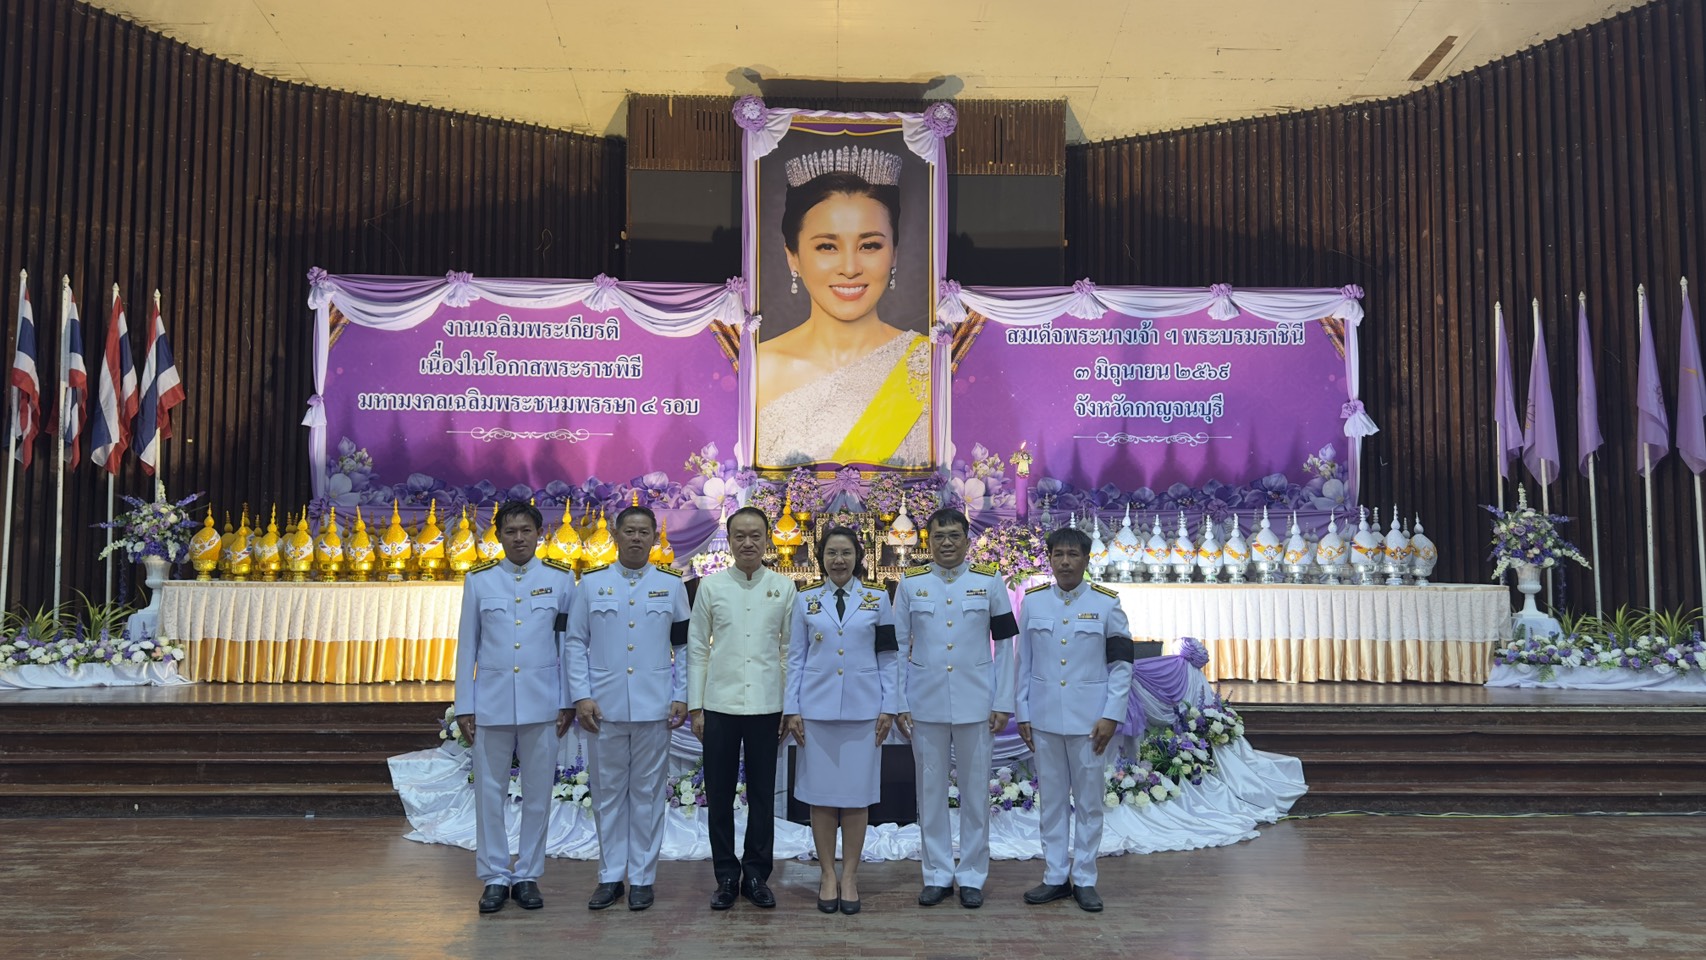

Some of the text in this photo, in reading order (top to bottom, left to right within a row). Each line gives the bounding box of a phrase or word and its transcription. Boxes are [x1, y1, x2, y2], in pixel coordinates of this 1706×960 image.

[443, 315, 620, 340] งานเฉลิมพระเกียรติ
[1006, 320, 1305, 345] สมเด็จพระนางเจ้า ฯ พระบรมราชินี
[419, 342, 643, 378] เนื่องในโอกาสพระราชพิธี
[1074, 357, 1231, 386] ๓ มิถุนายน ๒๕๖๙
[358, 388, 700, 415] มหามงคลเฉลิมพระชนมพรรษา ๔ รอบ
[1074, 393, 1224, 424] จังหวัดกาญจนบุรี
